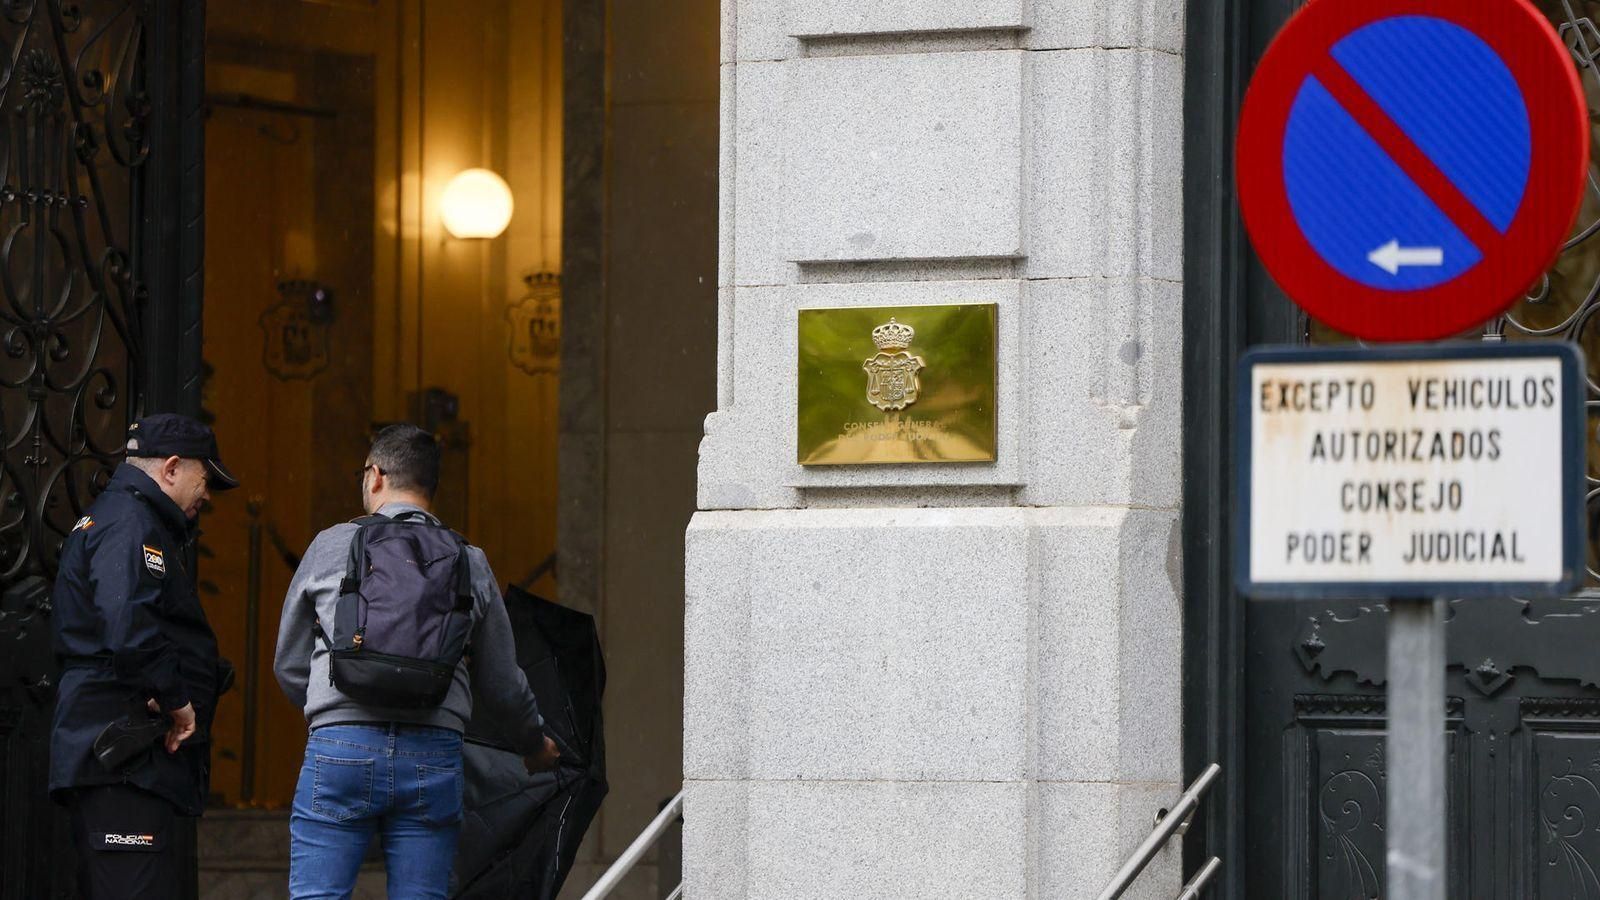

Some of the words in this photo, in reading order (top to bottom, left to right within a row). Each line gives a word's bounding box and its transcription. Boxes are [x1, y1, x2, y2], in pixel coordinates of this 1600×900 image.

[1260, 379, 1376, 412] EXCEPTO
[1407, 376, 1556, 410] VEHICULOS
[1310, 428, 1503, 462] AUTORIZADOS
[1340, 480, 1463, 513] CONSEJO
[1286, 531, 1373, 565] PODER
[1403, 530, 1526, 564] JUDICIAL
